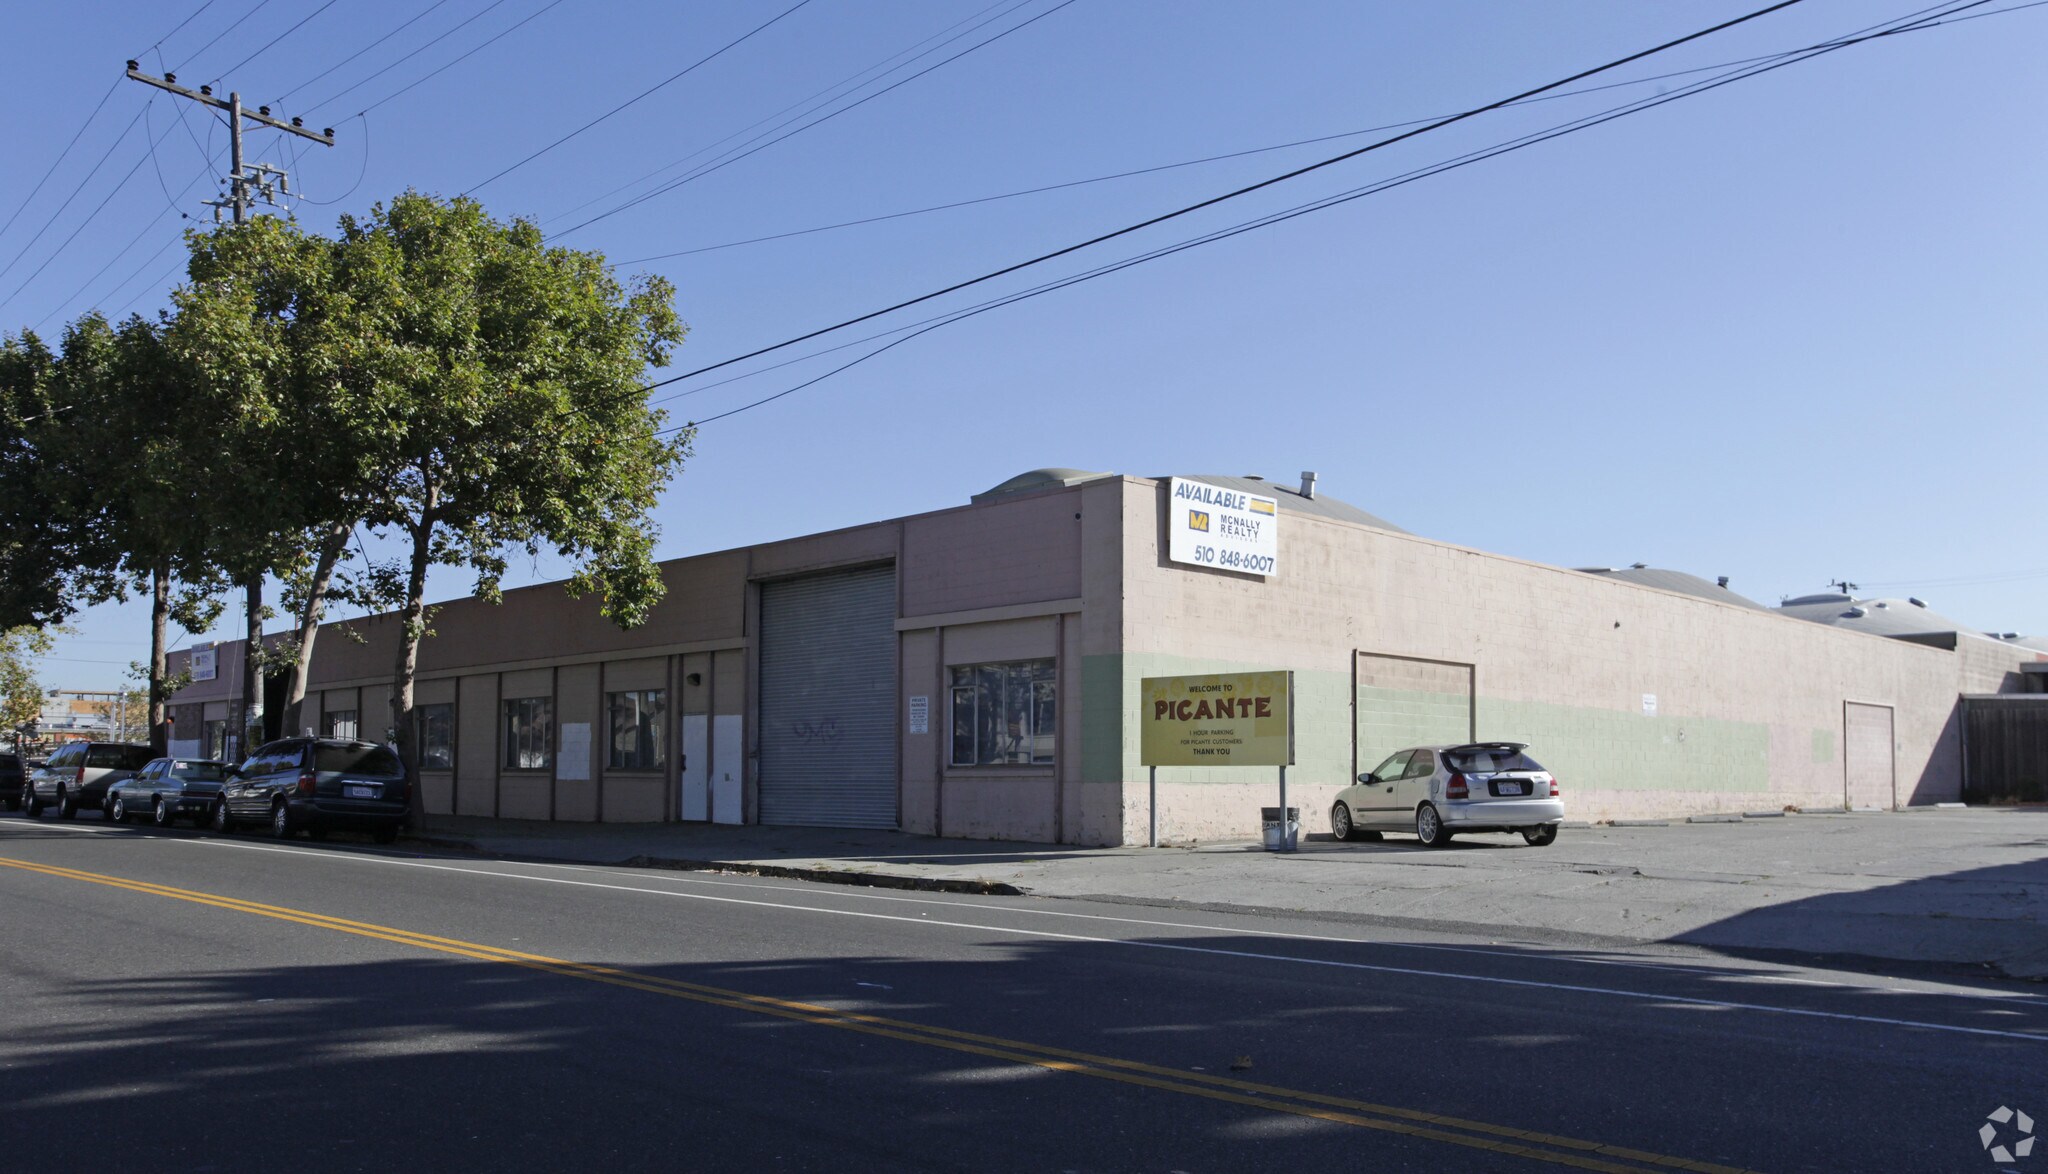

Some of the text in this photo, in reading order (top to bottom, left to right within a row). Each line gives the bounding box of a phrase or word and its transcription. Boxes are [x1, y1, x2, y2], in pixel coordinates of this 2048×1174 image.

[1175, 482, 1246, 510] AVAILABLE
[1220, 514, 1260, 529] MCNALLY
[1220, 524, 1259, 538] REALTY
[1194, 545, 1215, 563] 510
[1189, 684, 1233, 693] WELCOME TO
[1154, 696, 1272, 722] PICANTE
